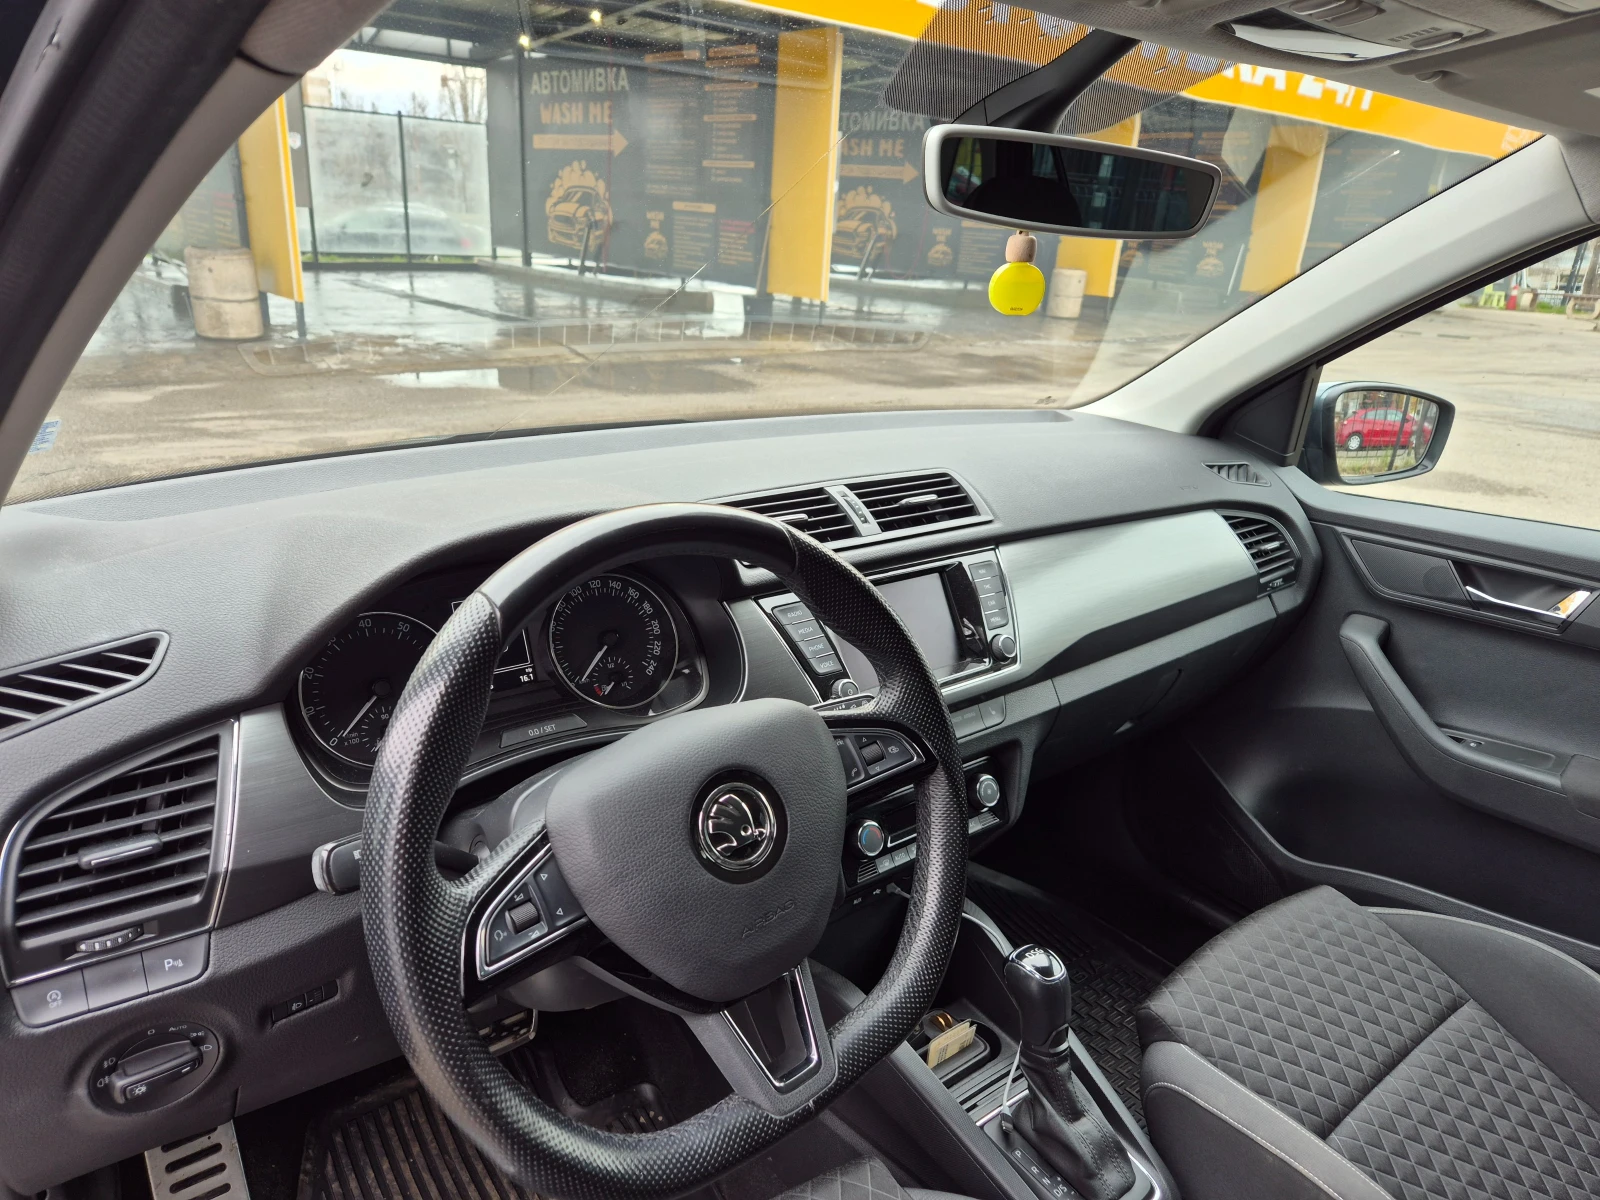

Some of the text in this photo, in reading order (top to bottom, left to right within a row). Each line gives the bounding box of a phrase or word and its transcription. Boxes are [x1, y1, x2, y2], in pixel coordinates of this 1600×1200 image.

[531, 67, 629, 95] АВТОМИВКА
[540, 100, 613, 124] WASH ME
[879, 138, 905, 158] ME
[588, 579, 601, 588] 120
[608, 580, 622, 590] 140
[569, 585, 583, 597] 100
[627, 586, 640, 600] 160
[642, 600, 654, 614] 180
[787, 610, 803, 618] RADIO
[358, 618, 372, 628] 40
[397, 621, 410, 633] 50
[650, 619, 661, 635] 200
[798, 626, 814, 635] MEDIA
[653, 640, 662, 656] 220
[808, 643, 825, 652] PHONE
[645, 659, 658, 676] 240
[820, 660, 834, 668] VOICE
[303, 666, 315, 680] 20
[519, 673, 534, 683] 16.1
[544, 724, 556, 733] SET
[329, 737, 338, 747] 0
[894, 853, 906, 861] AUTO
[742, 899, 795, 939] AIRBAG
[1025, 947, 1045, 959] DSG
[49, 1000, 63, 1009] OFF
[1015, 1150, 1022, 1159] P
[1031, 1166, 1040, 1175] R
[1053, 1183, 1068, 1197] D/S
